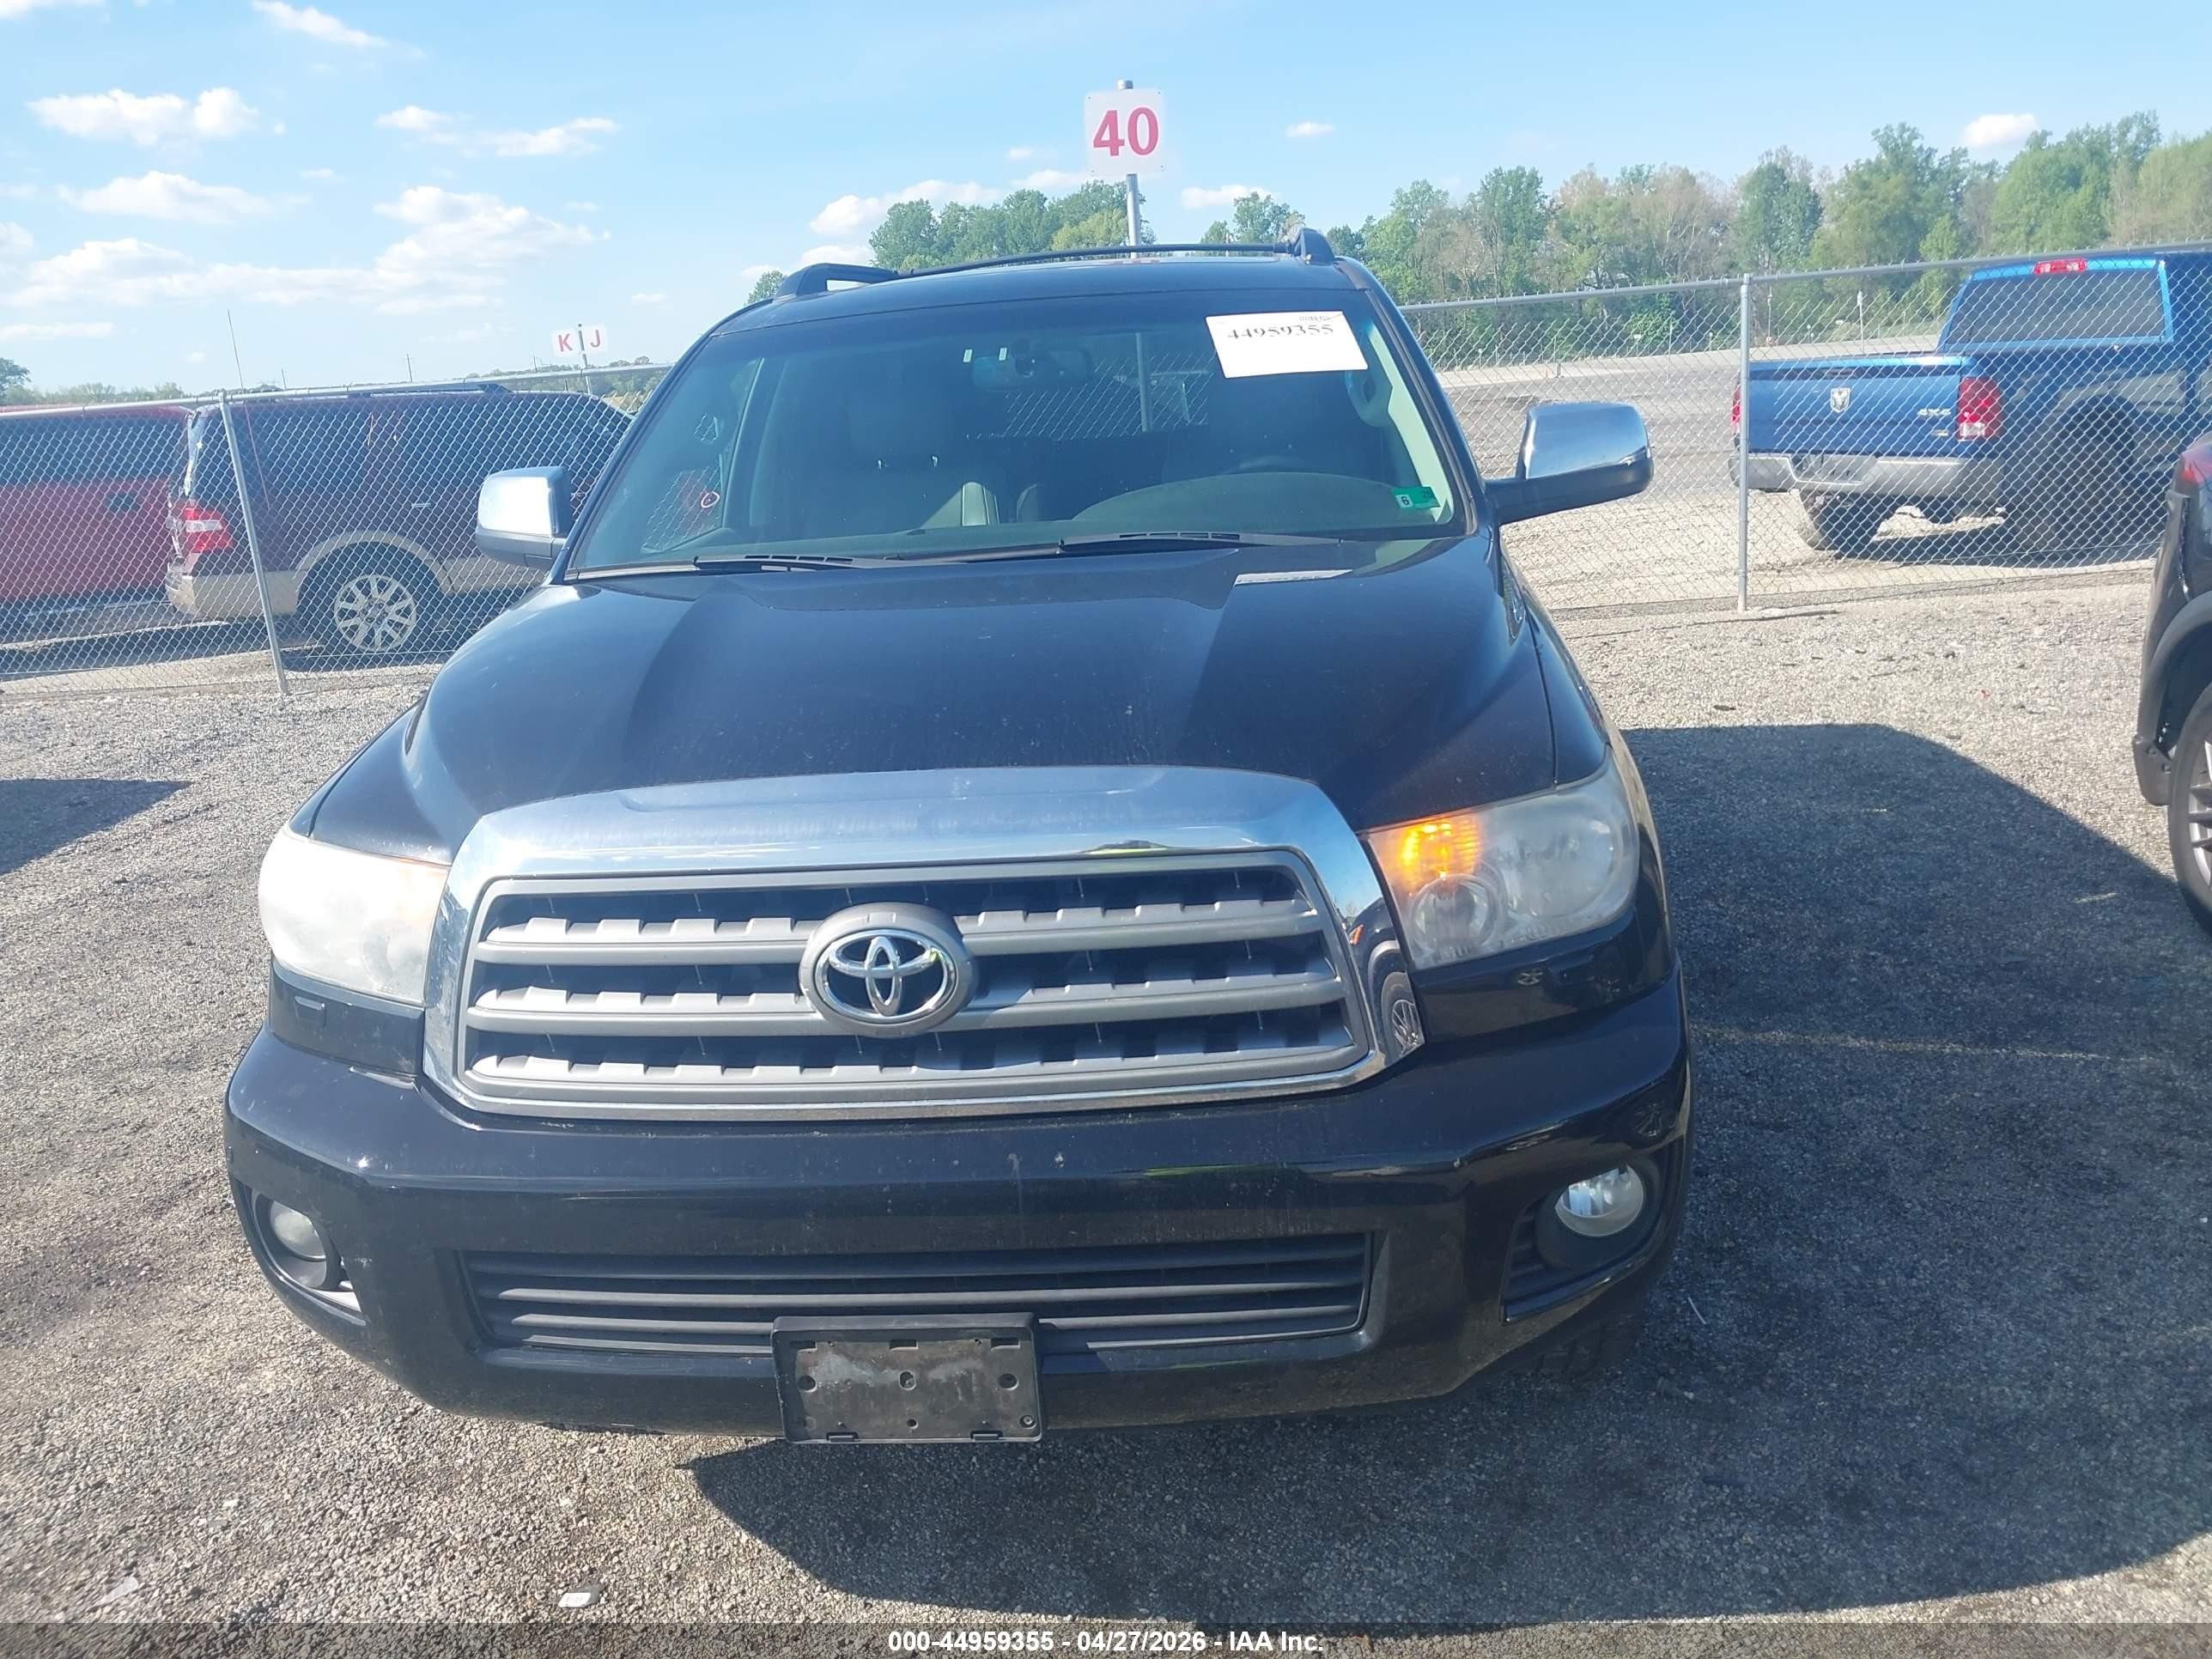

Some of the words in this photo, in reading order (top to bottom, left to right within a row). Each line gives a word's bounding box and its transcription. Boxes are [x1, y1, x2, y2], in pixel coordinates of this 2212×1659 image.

[1093, 106, 1159, 156] 40
[590, 329, 601, 348] J
[1227, 324, 1334, 339] 44959355
[557, 333, 574, 352] K
[1401, 495, 1411, 506] 6
